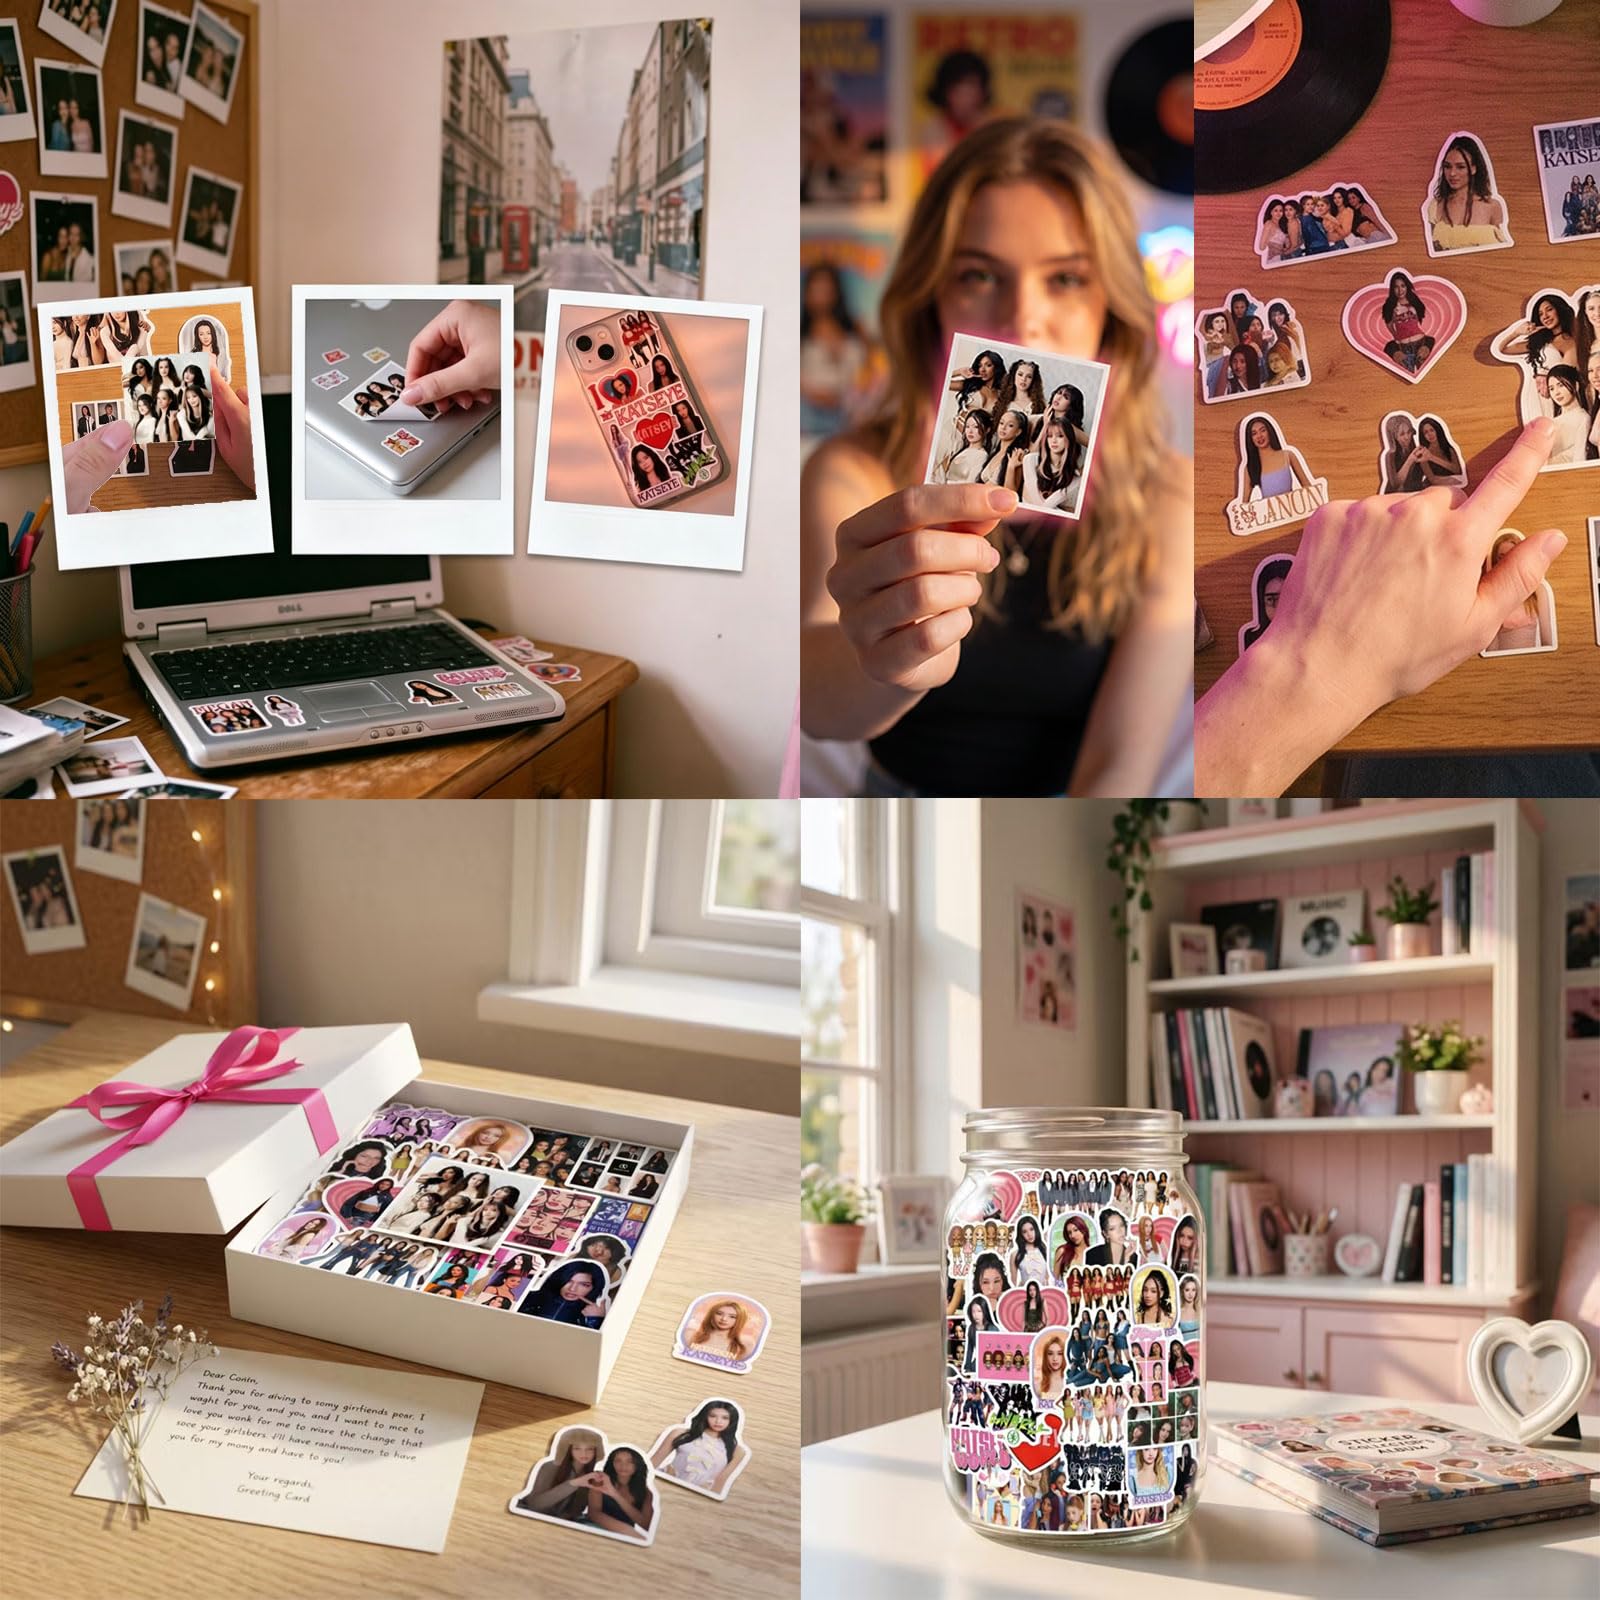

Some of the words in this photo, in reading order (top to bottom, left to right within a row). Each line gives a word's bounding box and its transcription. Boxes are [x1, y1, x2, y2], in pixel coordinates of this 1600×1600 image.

[614, 383, 687, 427] KATSEYE
[637, 478, 680, 502] KATSEYE
[203, 1370, 225, 1379] Dear
[198, 1381, 225, 1392] Thank
[250, 1389, 265, 1397] for
[301, 1396, 312, 1405] to
[420, 1413, 425, 1421] I
[183, 1405, 203, 1415] love
[204, 1411, 223, 1419] you
[257, 1416, 272, 1425] for
[276, 1421, 291, 1429] me
[296, 1423, 306, 1431] to
[340, 1429, 356, 1438] the
[360, 1432, 396, 1446] change
[401, 1438, 423, 1449] that
[223, 1398, 239, 1407] for
[311, 1413, 331, 1421] and
[335, 1414, 341, 1422] I
[344, 1418, 369, 1427] want
[374, 1421, 385, 1429] to
[414, 1426, 425, 1435] to
[168, 1433, 186, 1441] you
[190, 1433, 205, 1443] for
[208, 1439, 223, 1448] my
[258, 1446, 278, 1455] and
[281, 1447, 305, 1458] have
[309, 1452, 320, 1461] to
[199, 1424, 221, 1432] your
[288, 1434, 311, 1446] have
[380, 1448, 390, 1457] to
[394, 1450, 417, 1461] have
[1338, 1434, 1416, 1445] STICKER
[1379, 1445, 1429, 1454] ALBUM
[248, 1471, 269, 1481] Your
[237, 1484, 281, 1502] Greeting
[285, 1491, 311, 1503] Card
